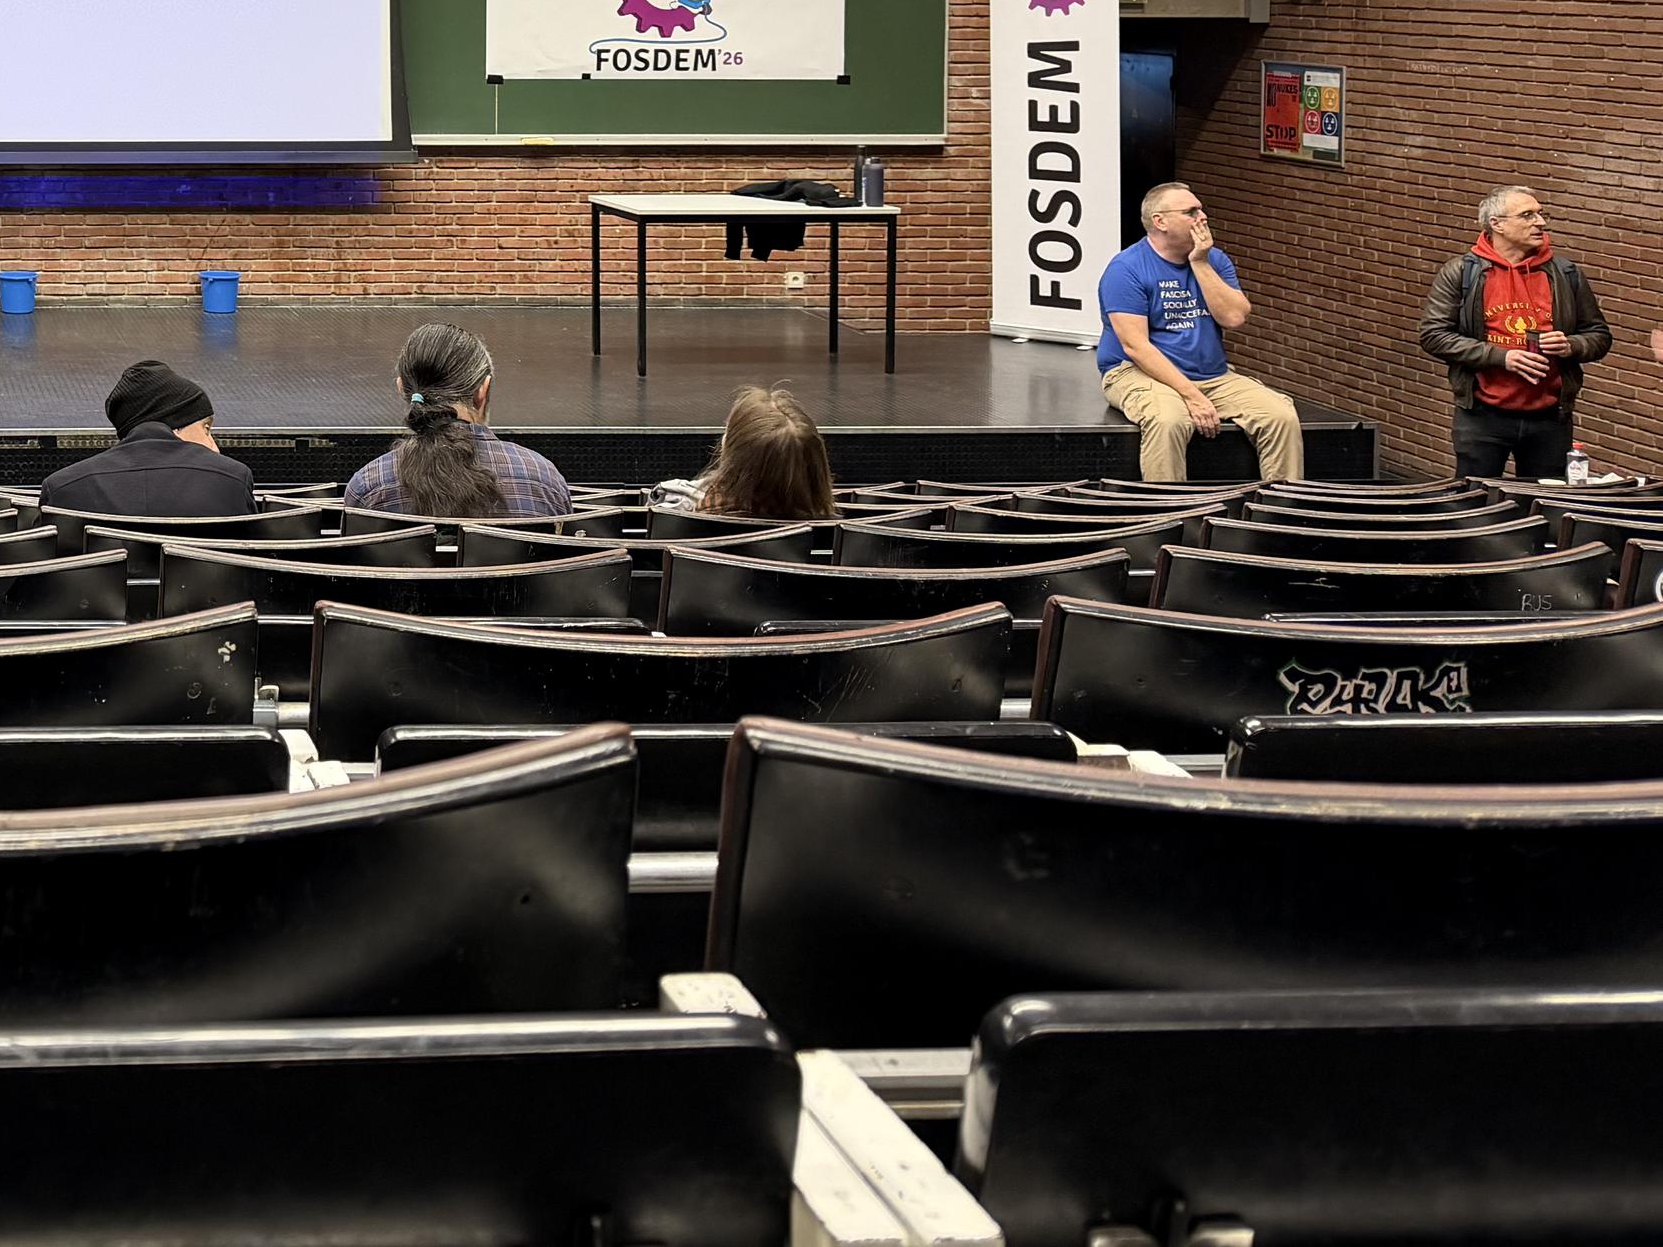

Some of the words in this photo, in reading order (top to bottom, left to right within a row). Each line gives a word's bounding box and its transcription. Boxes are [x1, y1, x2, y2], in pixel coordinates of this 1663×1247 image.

[595, 48, 744, 72] FOSDEM'26
[1265, 124, 1297, 142] STOP
[1026, 40, 1083, 312] FOSDEM
